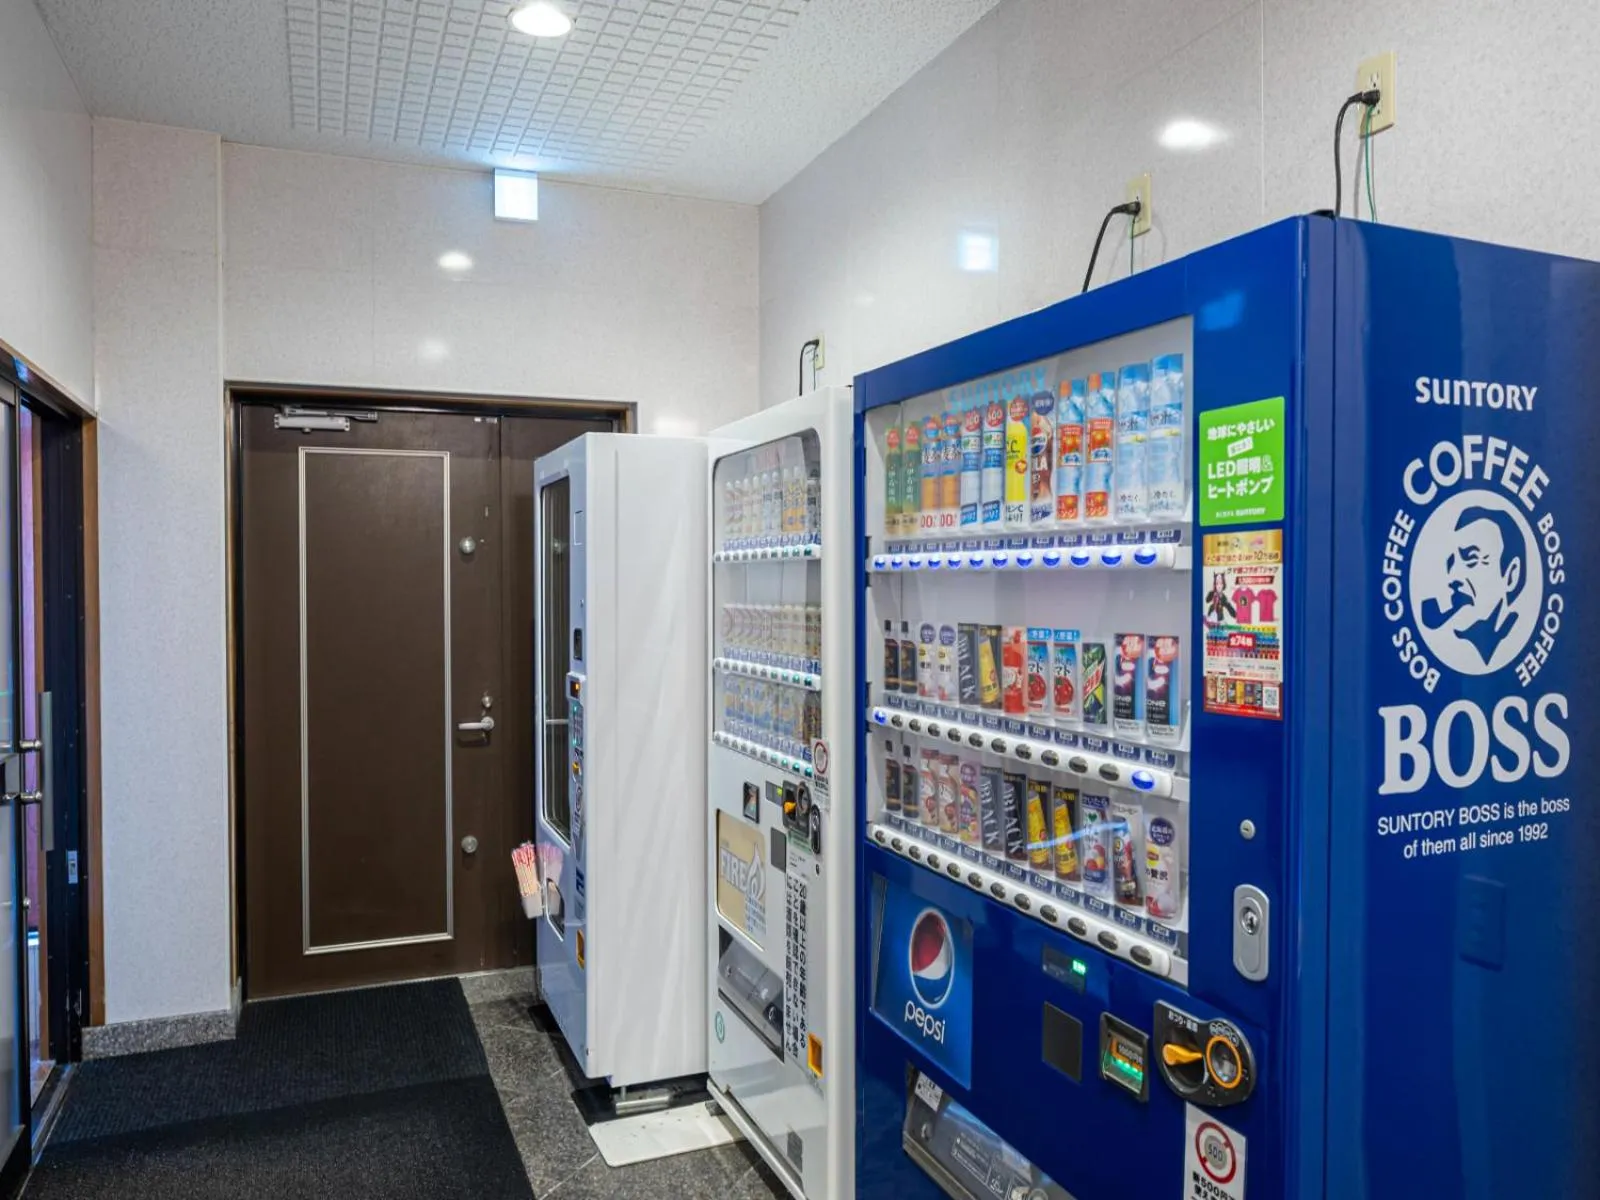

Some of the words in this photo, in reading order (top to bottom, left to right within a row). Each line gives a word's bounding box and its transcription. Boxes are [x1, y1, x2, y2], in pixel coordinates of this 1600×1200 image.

[1415, 376, 1538, 411] SUNTORY
[1208, 475, 1275, 499] ヒートポンプ
[1403, 434, 1551, 512] COFFEE
[1382, 509, 1416, 622] COFFEE
[1537, 512, 1565, 585] BOSS
[1391, 626, 1441, 694] BOSS
[1515, 593, 1564, 688] COFFEE
[1378, 692, 1570, 795] BOSS
[1377, 808, 1455, 836] SUNTORY
[1459, 803, 1500, 825] BOSS
[1503, 802, 1515, 819] is
[1518, 801, 1538, 817] the
[1540, 797, 1570, 813] boss
[1403, 839, 1417, 859] of
[1421, 836, 1456, 855] them
[1460, 830, 1475, 850] all
[1480, 830, 1514, 848] since
[1518, 822, 1549, 842] 1992
[720, 847, 749, 895] FIRE
[904, 999, 946, 1045] pepsi
